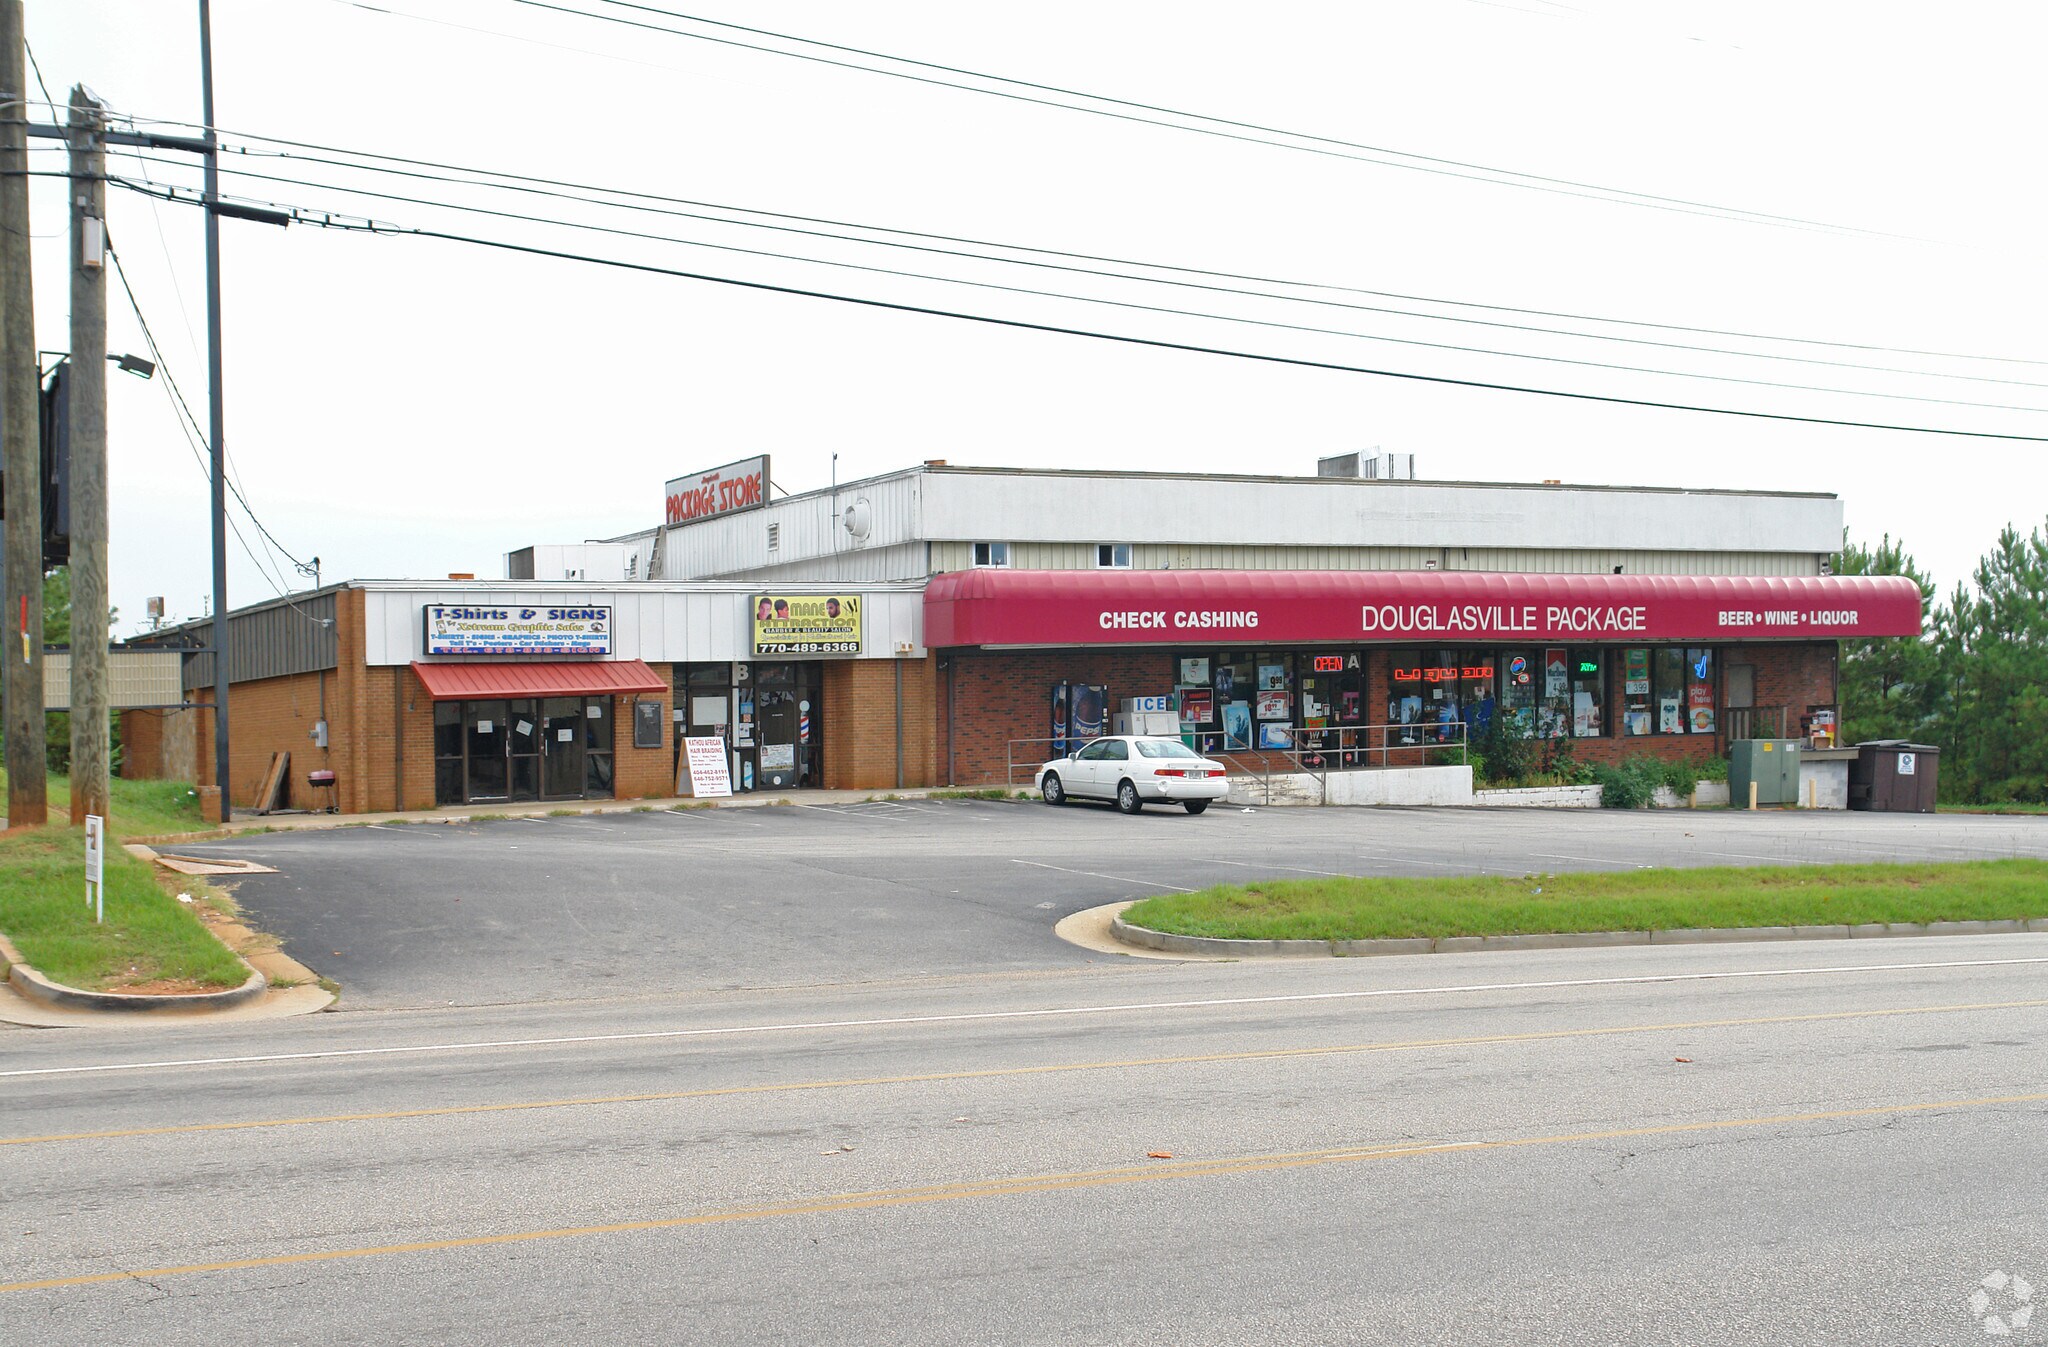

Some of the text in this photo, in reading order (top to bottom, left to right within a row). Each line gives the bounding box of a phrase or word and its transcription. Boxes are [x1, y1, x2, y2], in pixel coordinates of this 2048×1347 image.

[666, 471, 761, 524] PACKAGE STORE
[434, 608, 607, 620] T-Shirts & SIGNS
[790, 602, 825, 616] MANE
[760, 618, 856, 628] ATTRACTION
[1099, 611, 1258, 628] CHECK CASHING
[1362, 605, 1646, 631] DOUGLASVILLE PACKAGE
[1719, 610, 1858, 626] BEER WINE LIQUOR
[457, 622, 584, 633] Xstream Graphic Sales
[760, 643, 857, 653] 770-489-6366
[1315, 657, 1342, 671] OPEN
[1348, 654, 1359, 669] A
[1580, 662, 1597, 671] ATM
[737, 664, 749, 680] B
[1690, 687, 1706, 697] play
[1137, 698, 1165, 711] ICE
[1695, 695, 1711, 703] here
